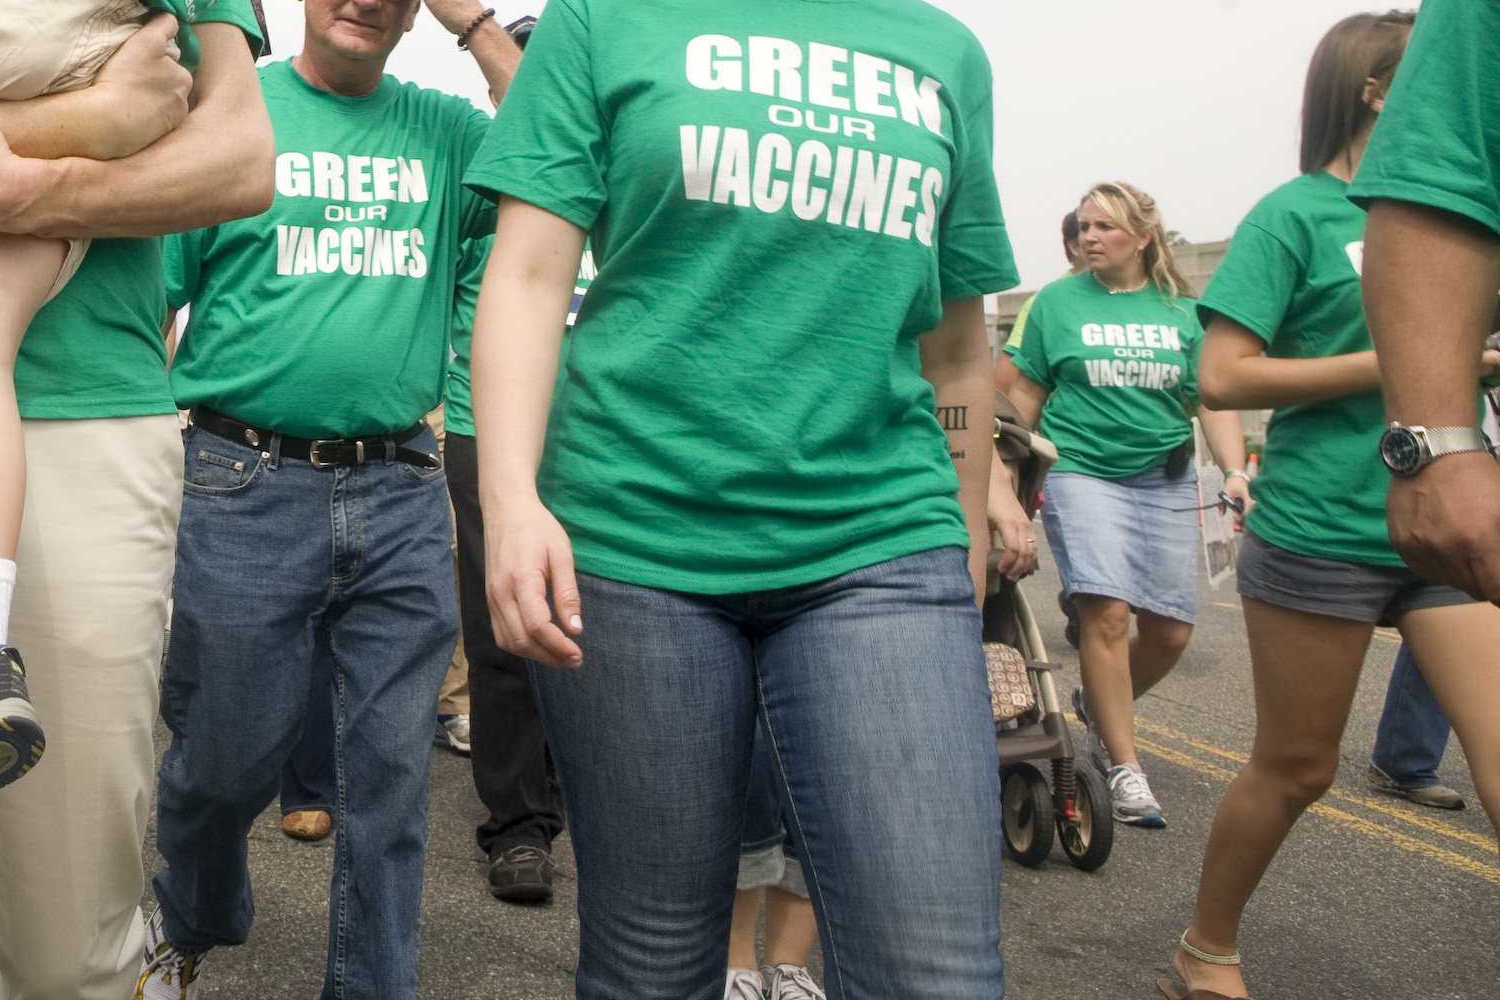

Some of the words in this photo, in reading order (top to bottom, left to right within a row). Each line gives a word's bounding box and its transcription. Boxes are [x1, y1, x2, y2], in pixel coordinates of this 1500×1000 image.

[685, 34, 945, 139] GREEN
[768, 104, 876, 141] OUR
[275, 151, 429, 204] GREEN
[679, 124, 944, 247] VACCINES
[324, 204, 388, 222] OUR
[276, 224, 428, 279] VACCINES
[1081, 323, 1181, 351] GREEN
[1113, 347, 1155, 359] OUR
[1084, 359, 1181, 390] VACCINES
